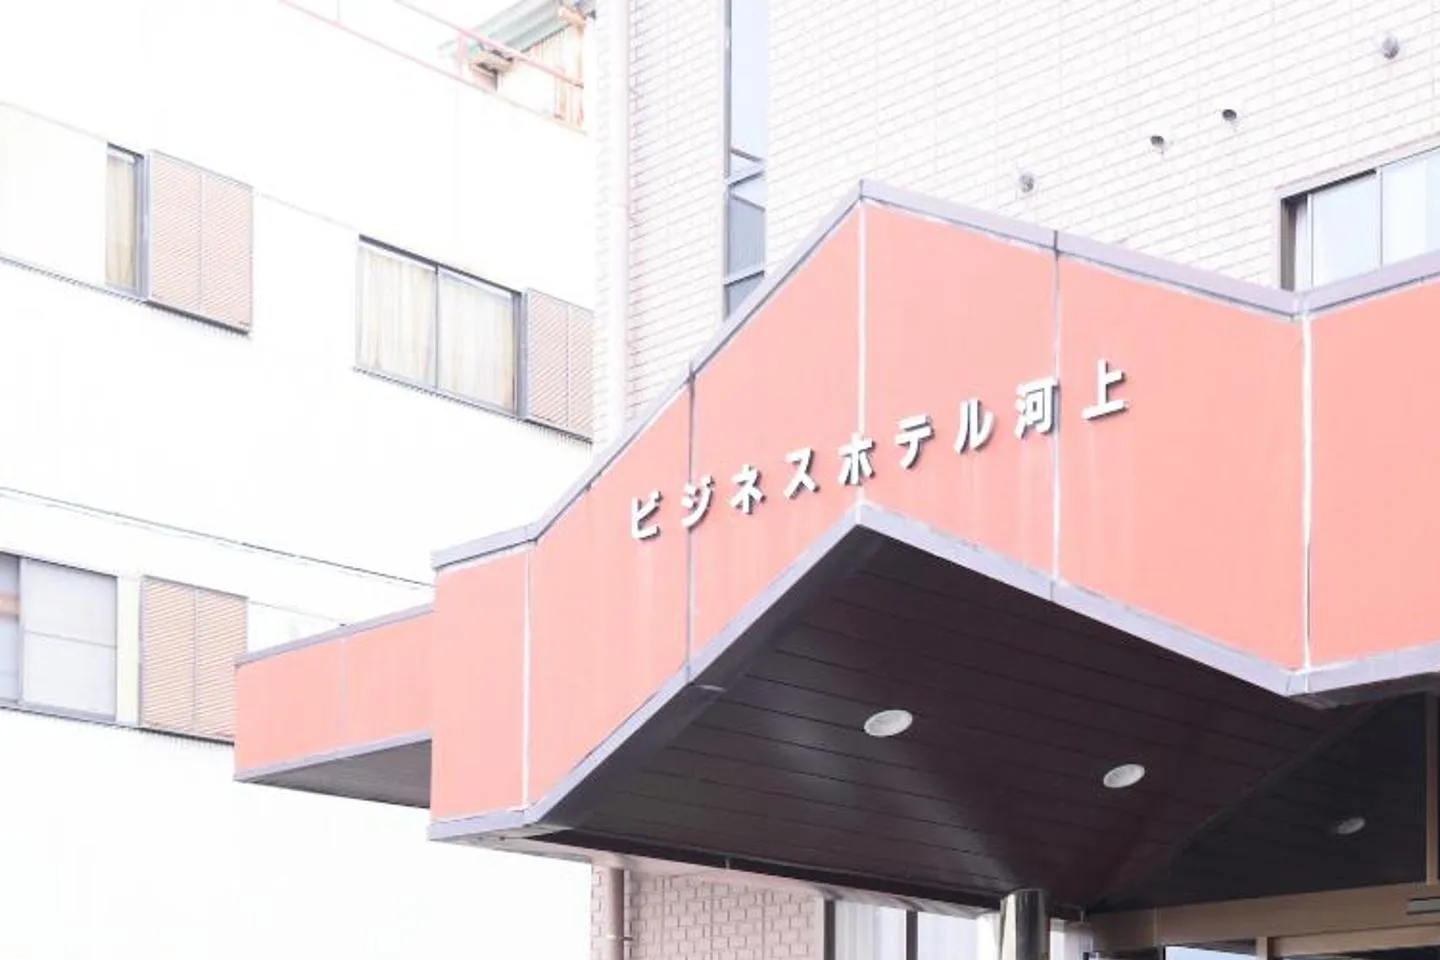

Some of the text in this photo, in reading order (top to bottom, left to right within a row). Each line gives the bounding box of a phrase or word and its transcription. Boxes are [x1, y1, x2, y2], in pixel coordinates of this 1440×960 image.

[630, 358, 1129, 541] ビジネスホテル河上
